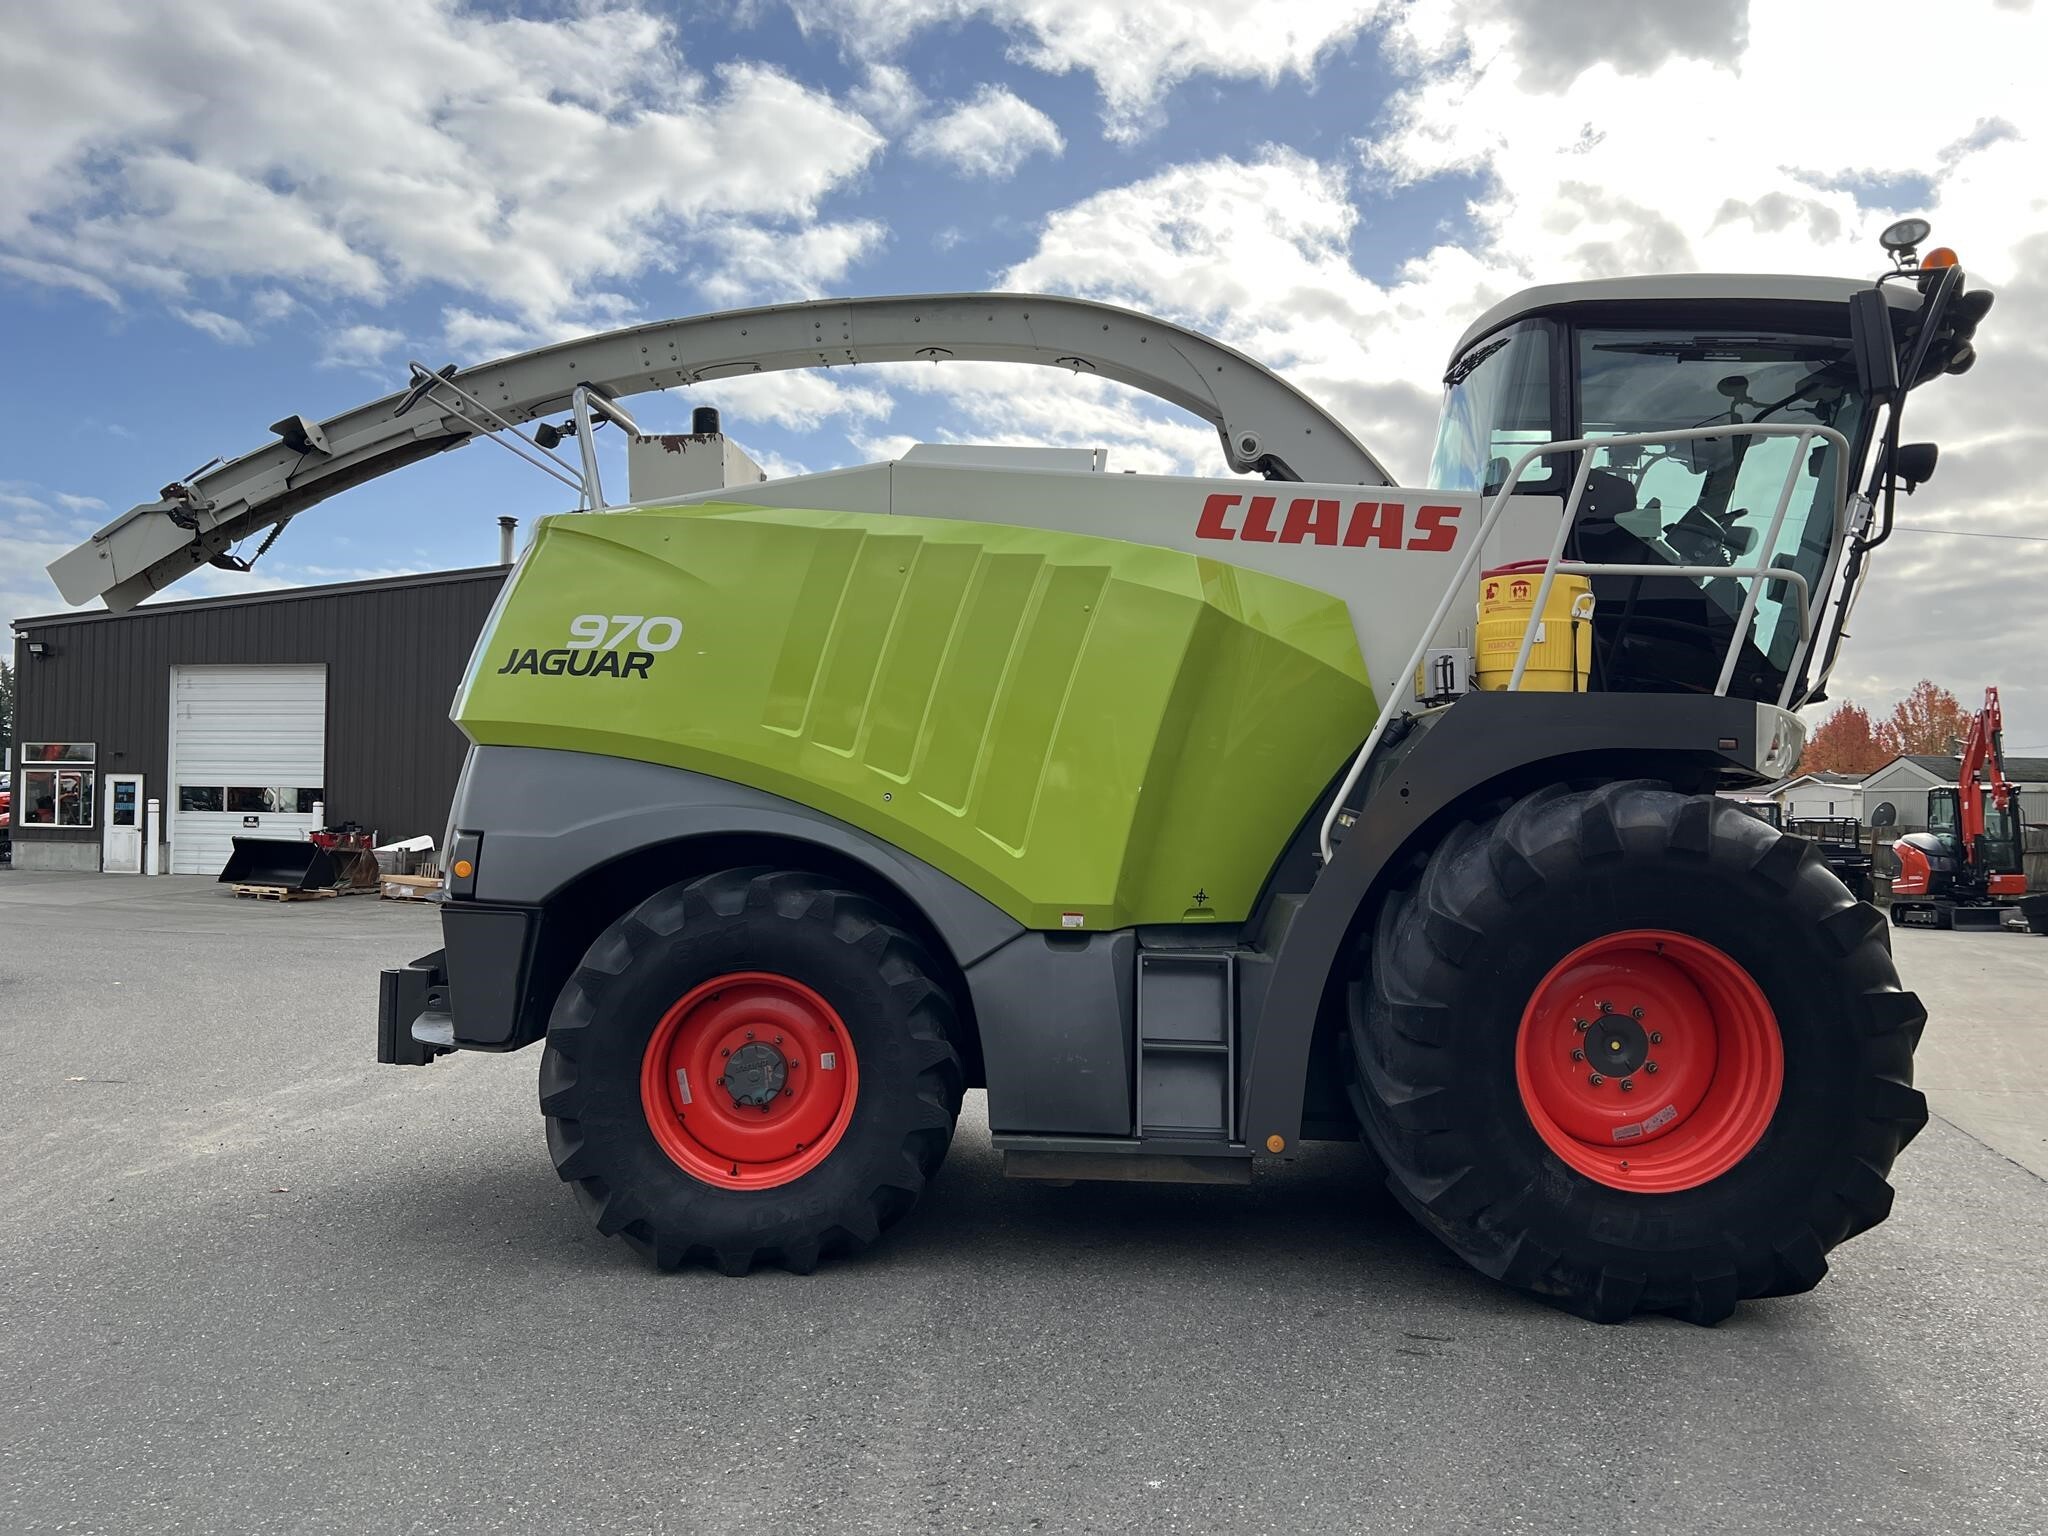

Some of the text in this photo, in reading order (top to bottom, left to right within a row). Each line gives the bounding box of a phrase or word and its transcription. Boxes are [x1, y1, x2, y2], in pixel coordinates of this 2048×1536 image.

[1195, 494, 1462, 552] CLAAS
[566, 614, 683, 652] 970
[497, 648, 655, 679] JAGUAR
